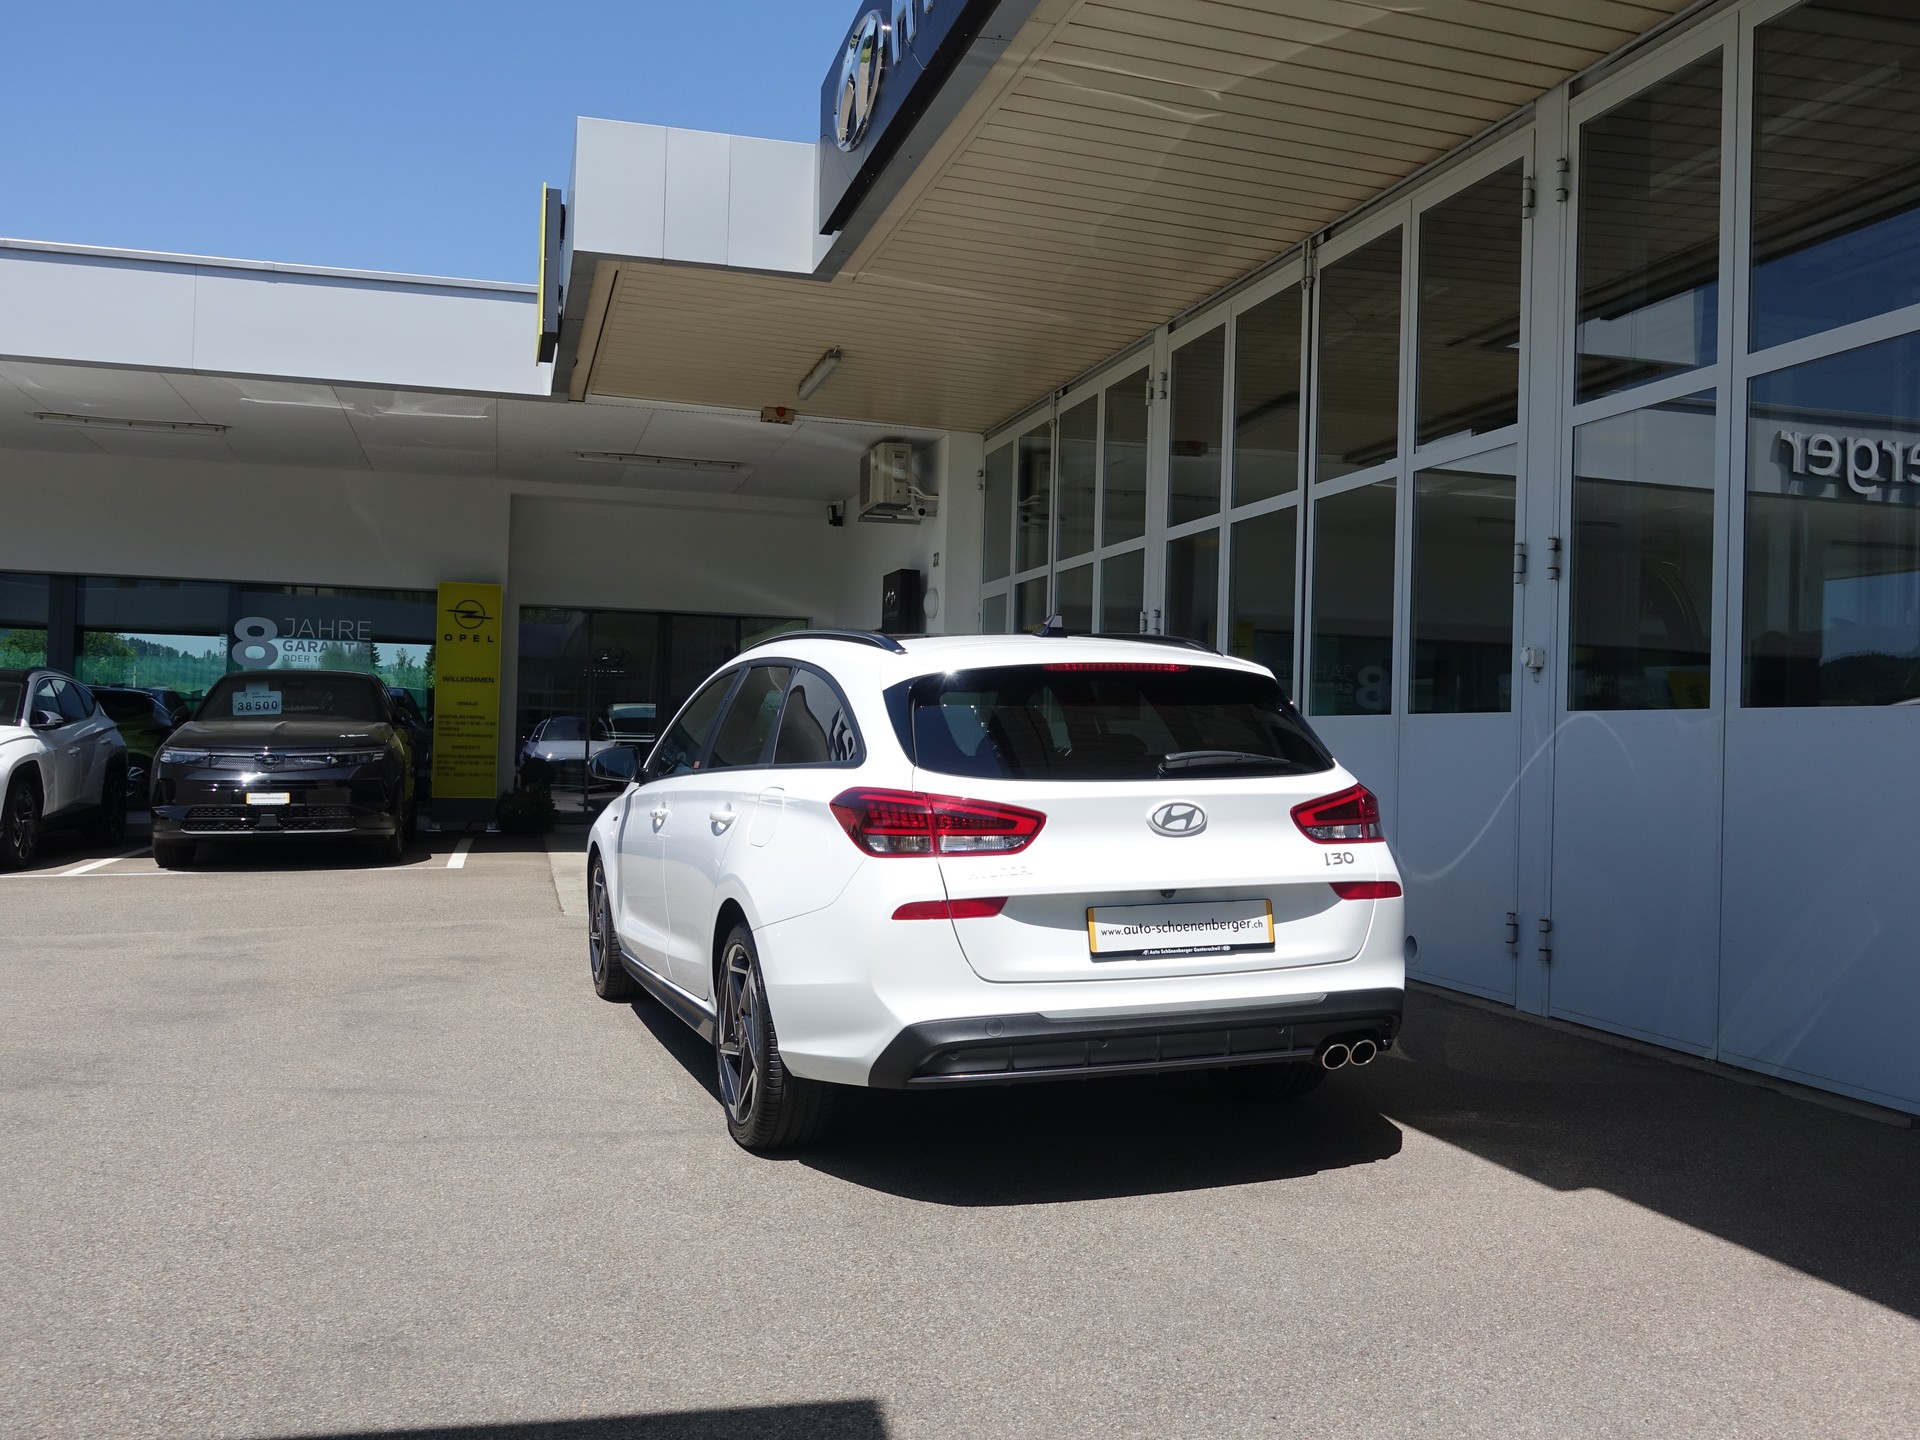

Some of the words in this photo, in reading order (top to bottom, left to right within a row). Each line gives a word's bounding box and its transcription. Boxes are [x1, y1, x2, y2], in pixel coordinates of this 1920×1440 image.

[283, 618, 372, 641] JAHRE
[232, 617, 278, 668] 8
[444, 634, 494, 643] OPEL
[283, 640, 372, 655] GARANTIE
[282, 654, 310, 663] ODER
[1101, 918, 1264, 936] www.auto-schoenenberger.ch
